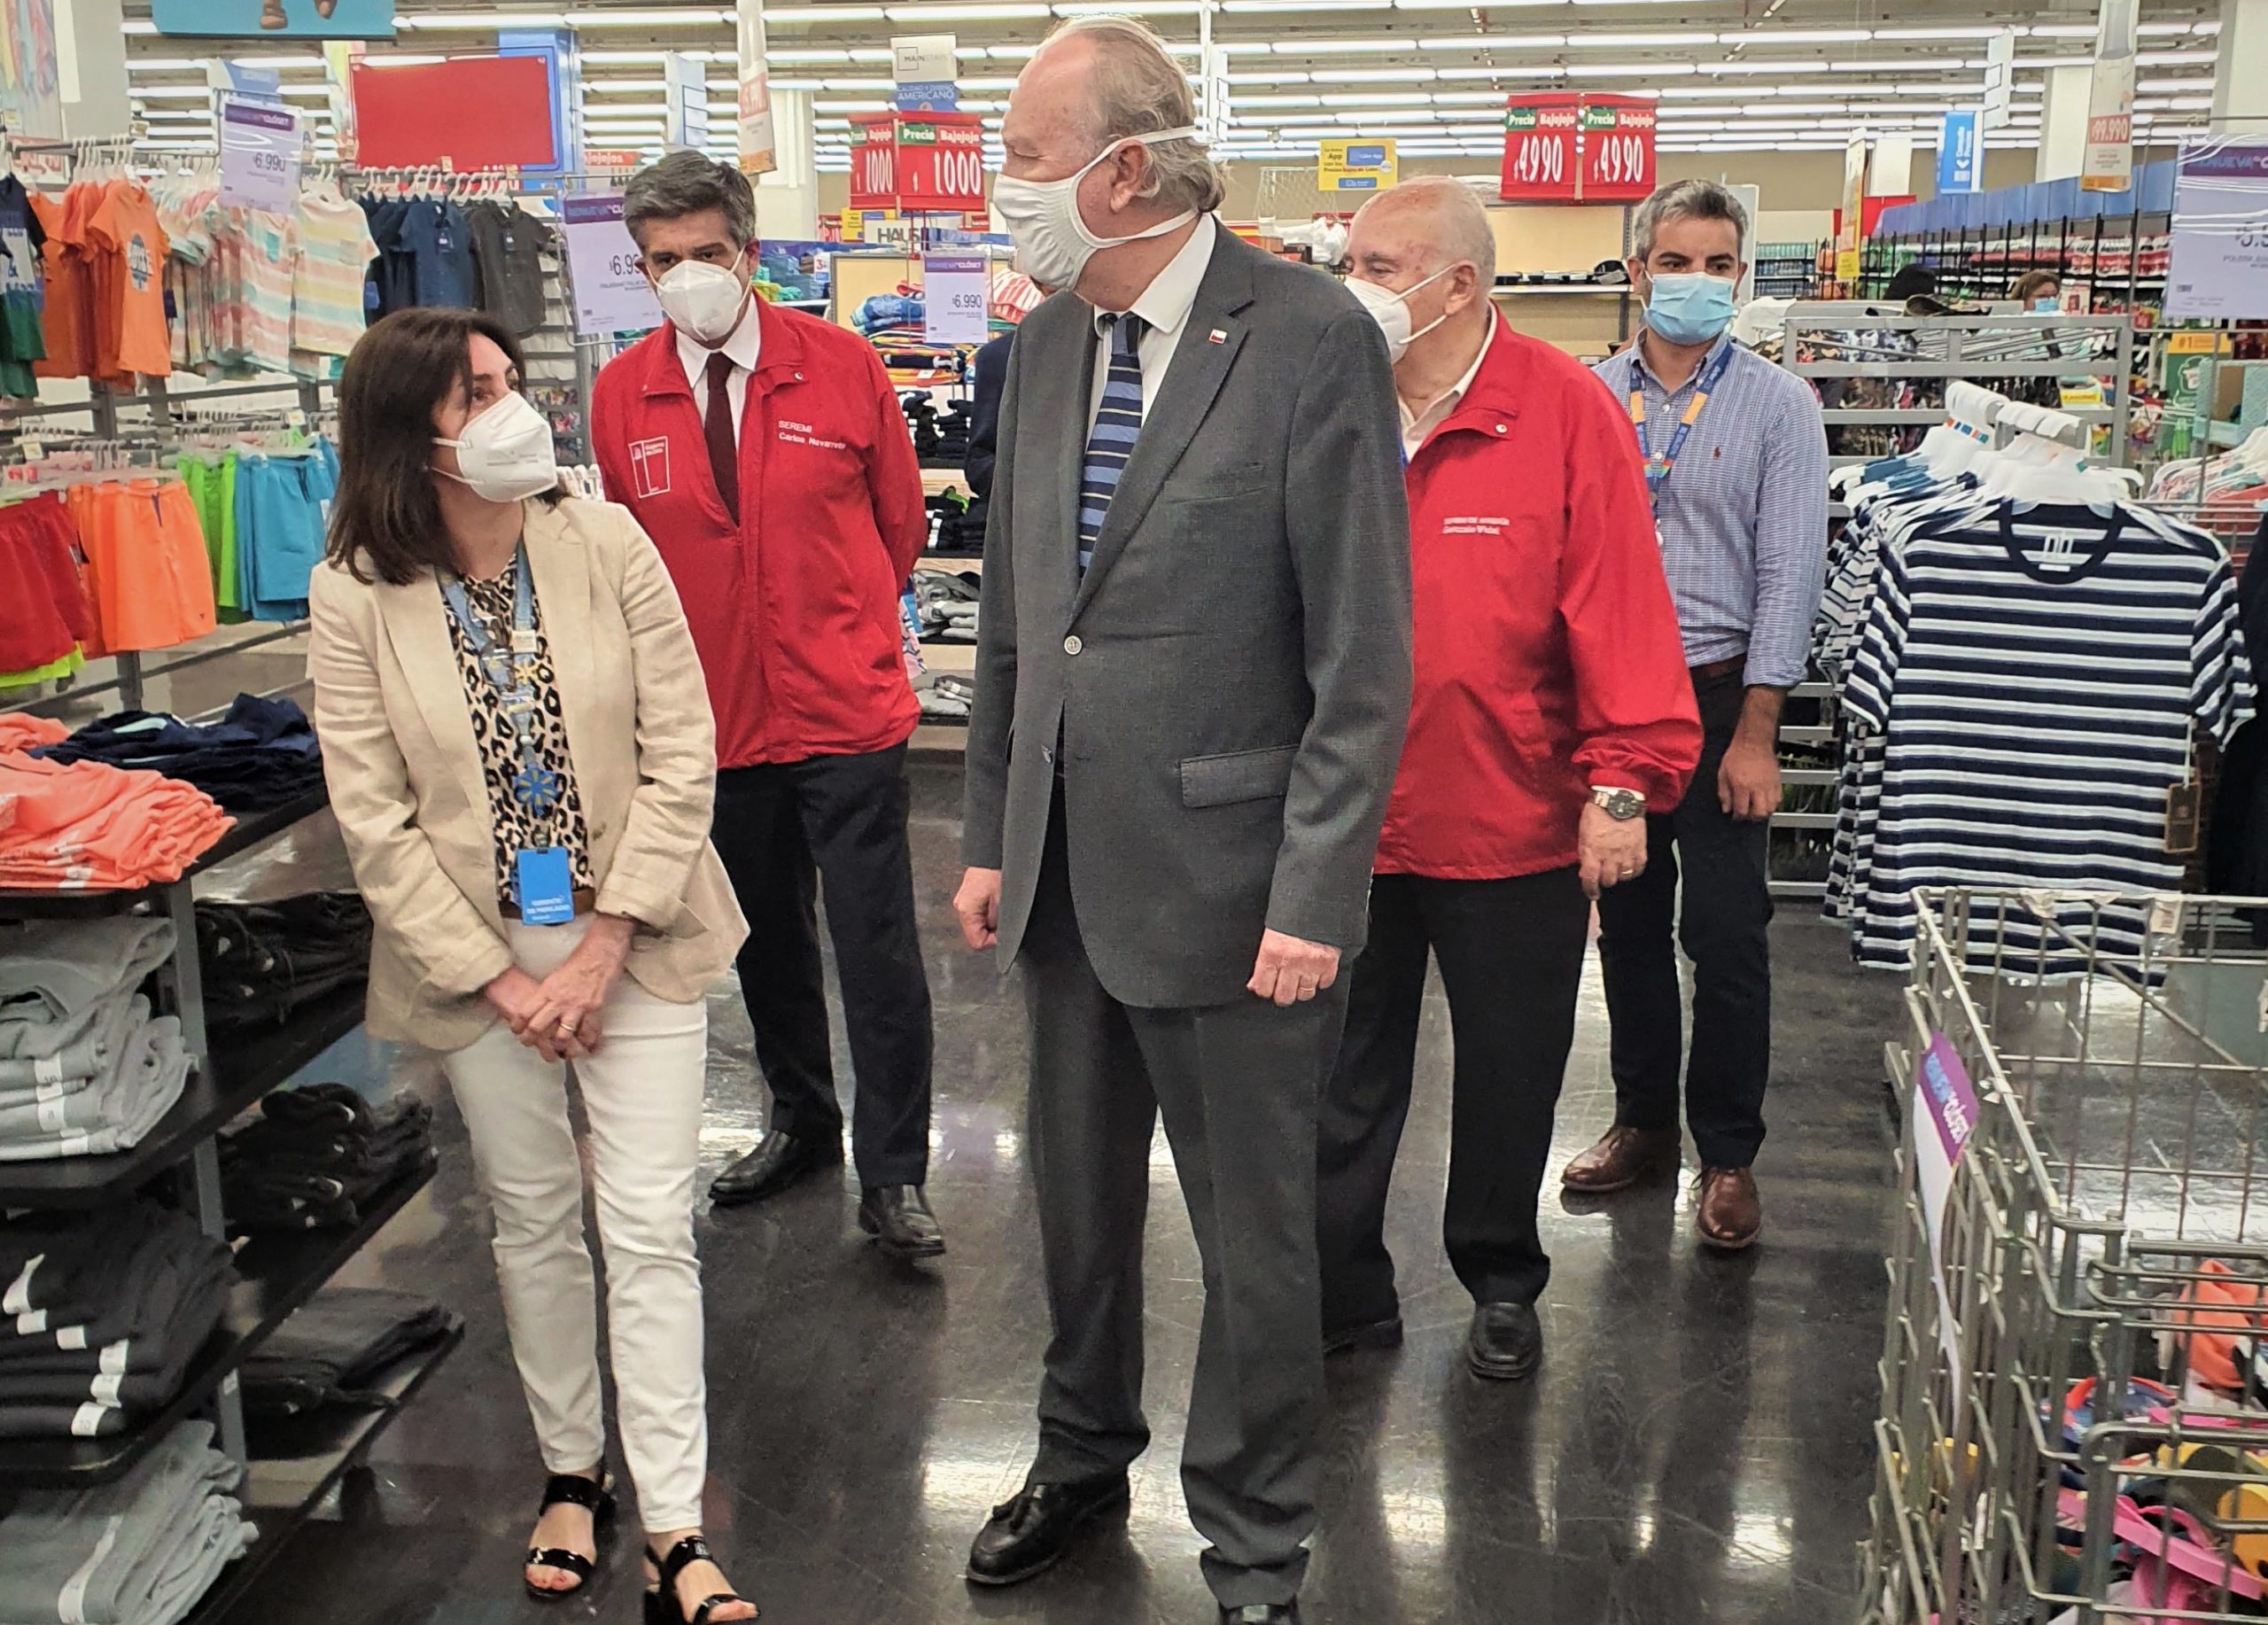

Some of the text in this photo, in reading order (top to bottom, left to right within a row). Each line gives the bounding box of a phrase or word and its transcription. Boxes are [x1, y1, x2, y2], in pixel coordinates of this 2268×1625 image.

[897, 90, 954, 101] AMERICANO
[1509, 113, 1576, 128] Precio Bajojojo
[1588, 113, 1655, 128] Precio Bajojojo
[903, 128, 980, 144] Precio Bajojojo
[935, 150, 981, 195] 1000
[778, 420, 812, 433] SEREMI
[778, 432, 805, 444] Carlos
